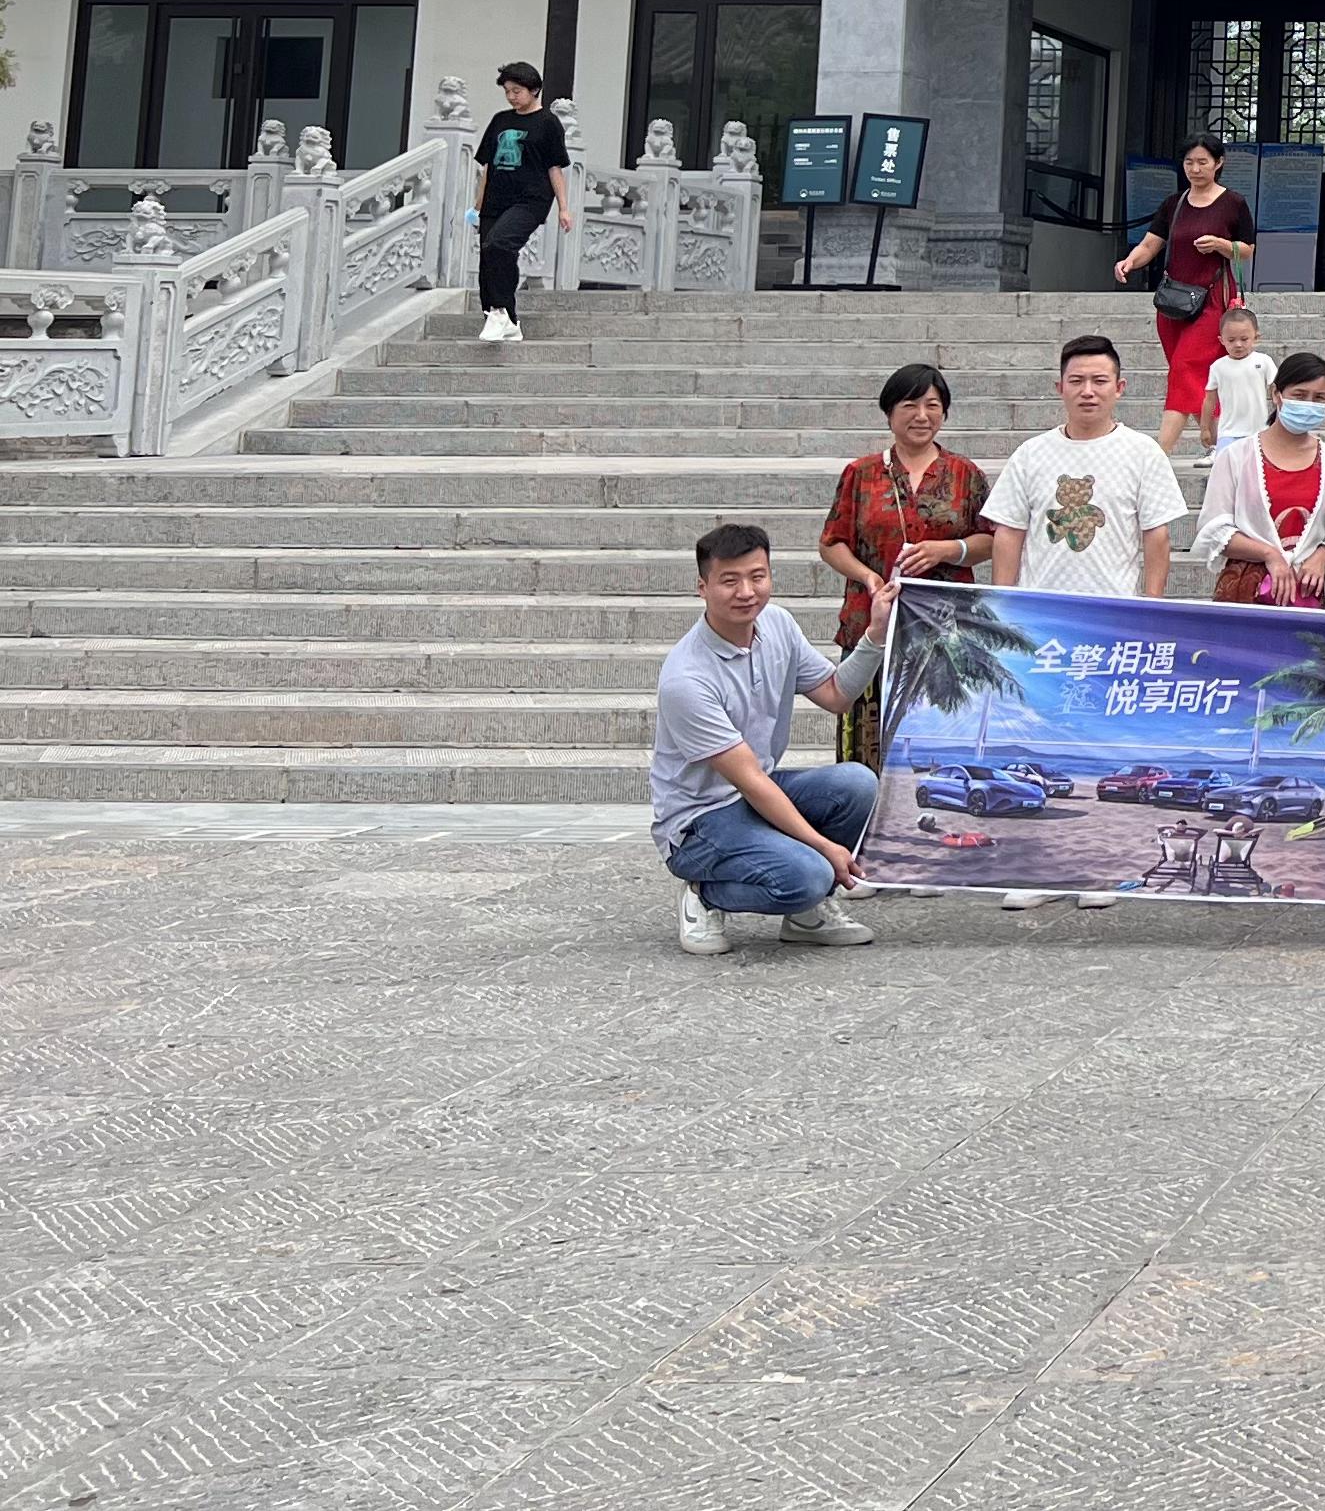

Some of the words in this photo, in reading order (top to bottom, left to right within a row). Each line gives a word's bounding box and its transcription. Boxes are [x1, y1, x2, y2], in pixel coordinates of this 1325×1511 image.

[1027, 638, 1177, 681] 全擎相遇
[1104, 677, 1241, 717] 悦享同行
